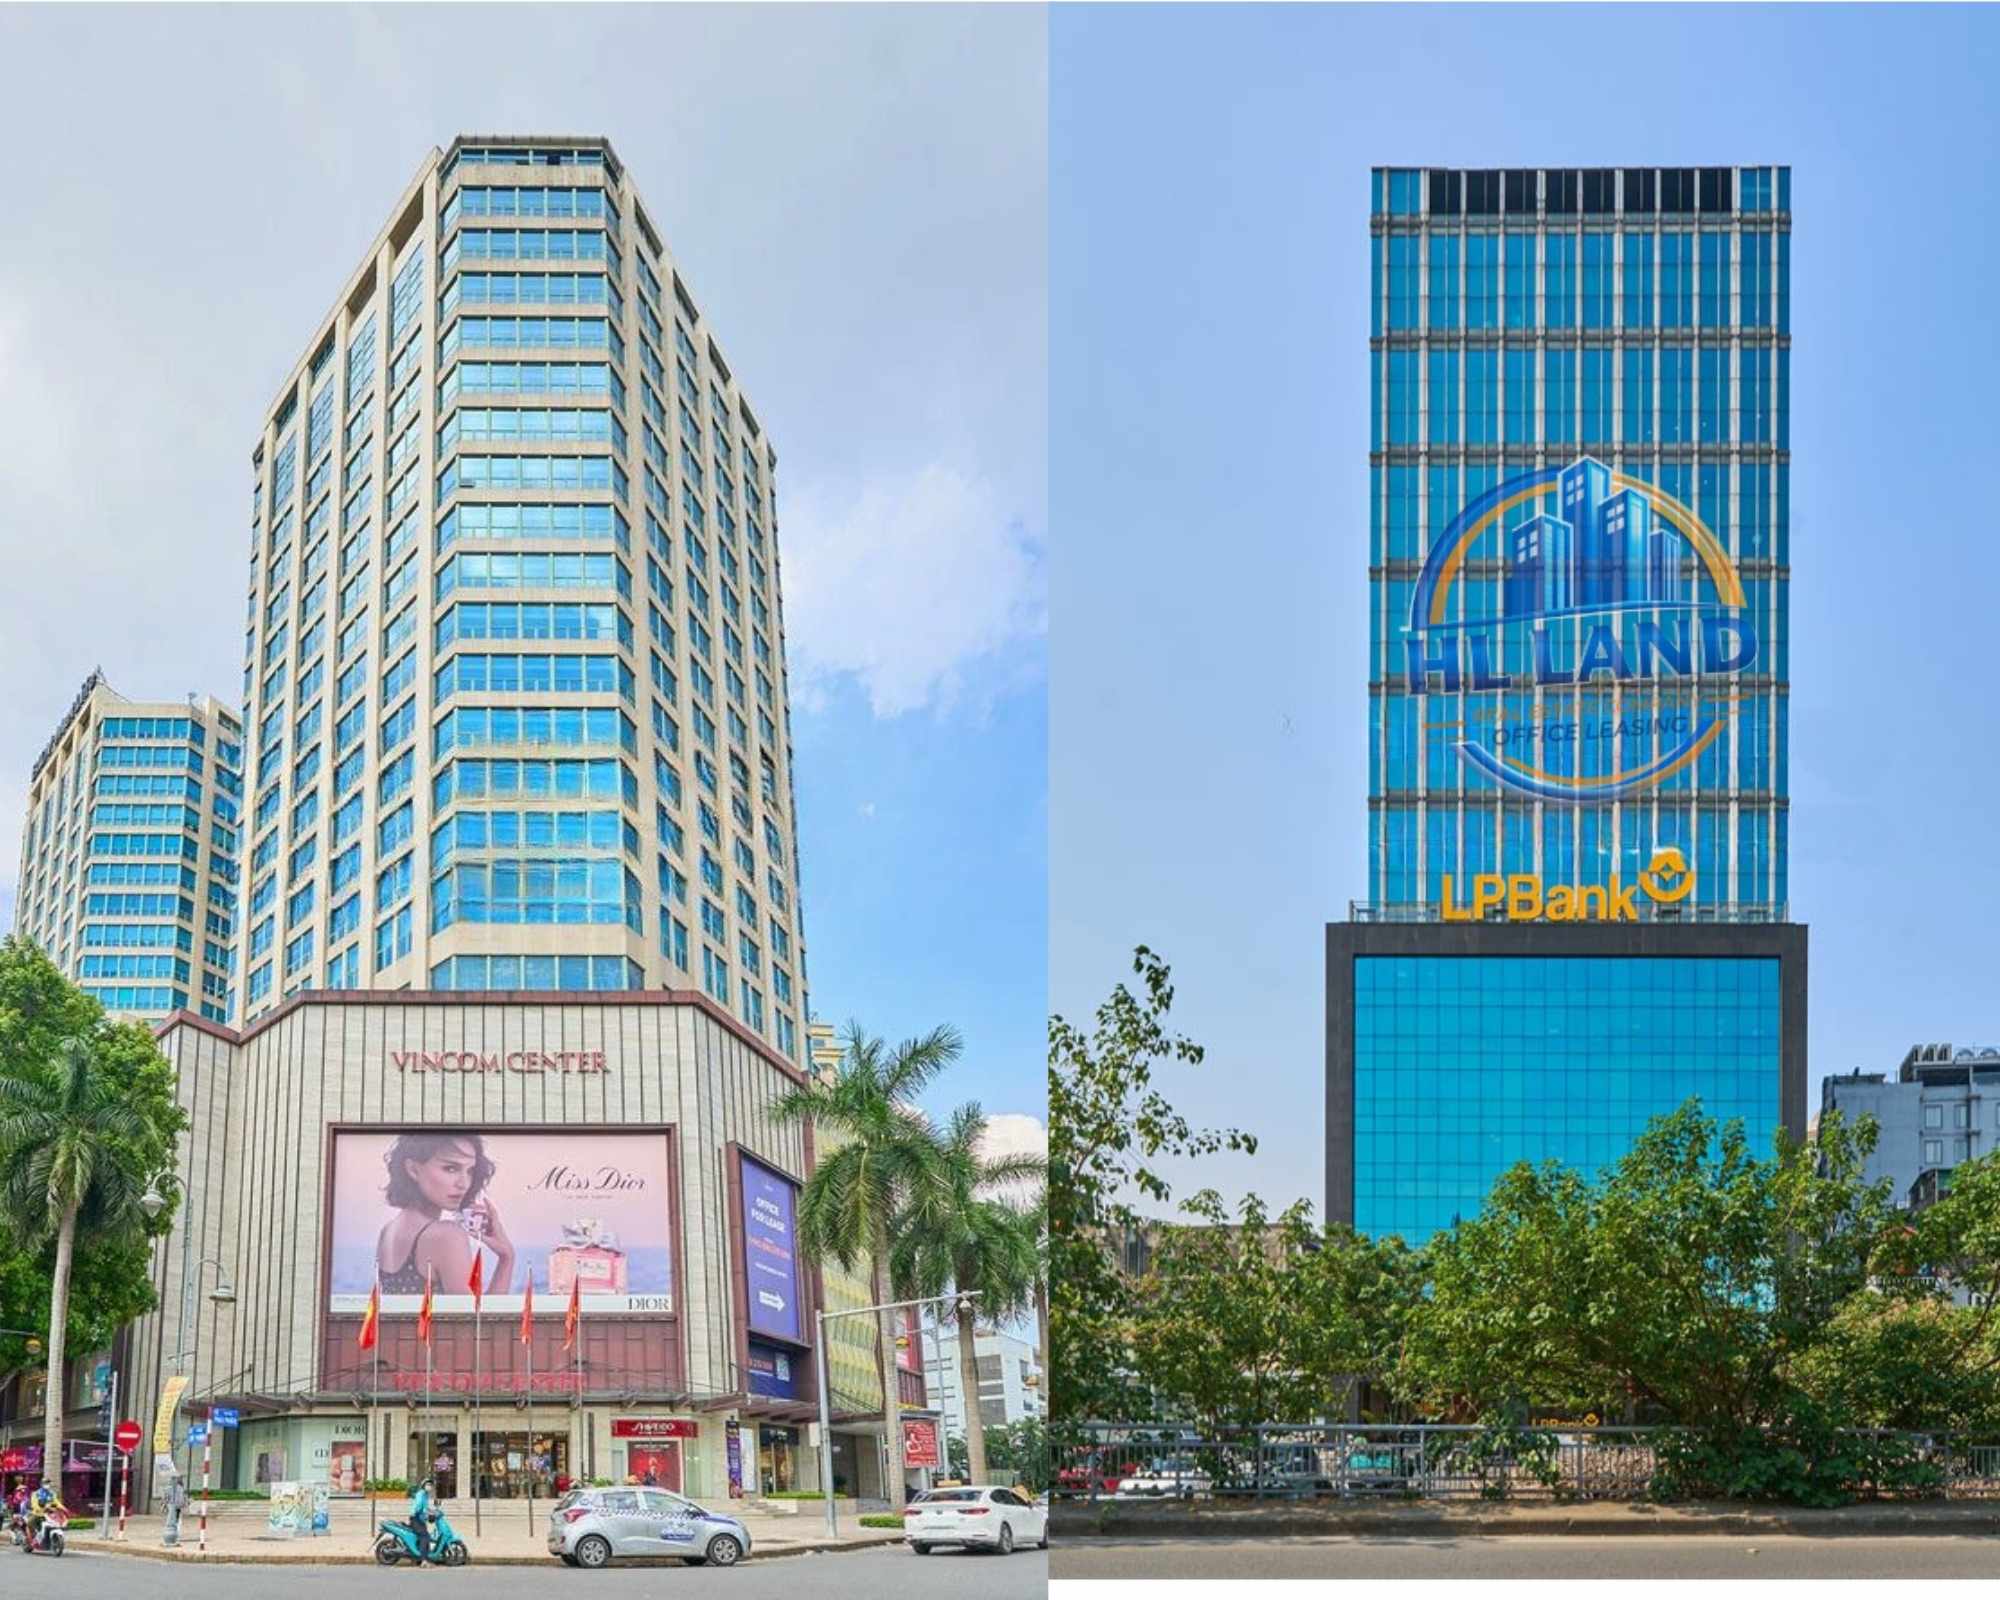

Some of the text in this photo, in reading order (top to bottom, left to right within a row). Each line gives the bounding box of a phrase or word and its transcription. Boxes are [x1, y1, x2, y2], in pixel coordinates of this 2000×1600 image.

[1442, 874, 1638, 921] LPBank
[391, 1052, 611, 1074] VINCOM CENTER
[527, 1166, 646, 1191] Miss Dior
[628, 1297, 669, 1311] DIOR
